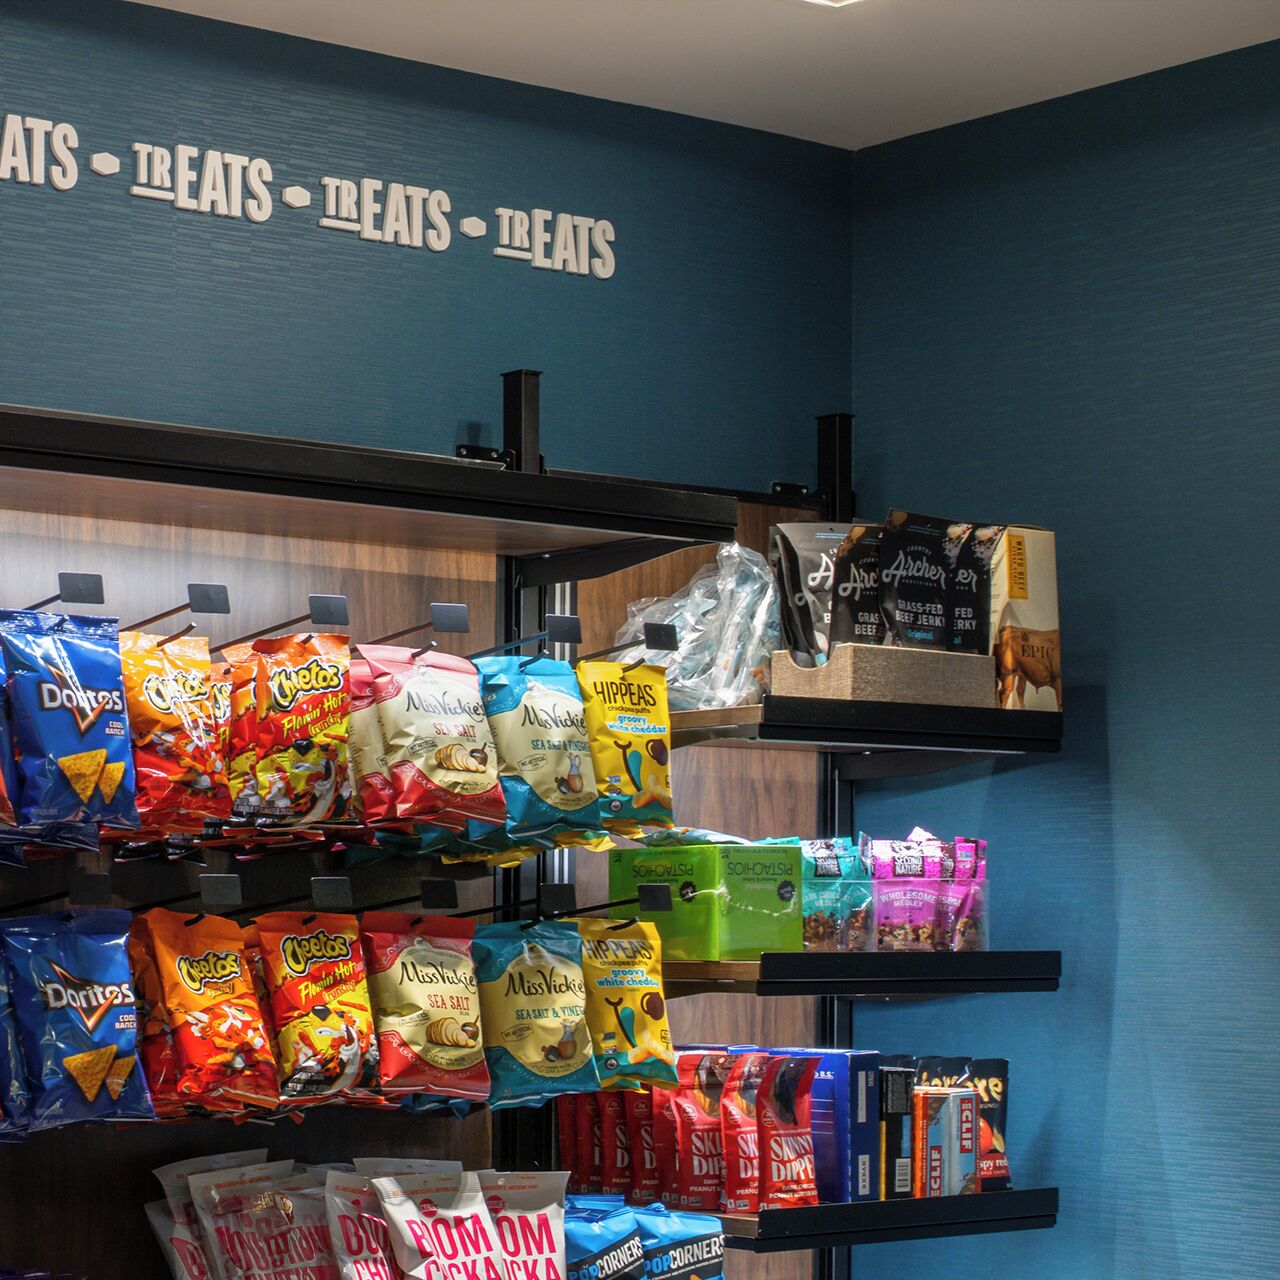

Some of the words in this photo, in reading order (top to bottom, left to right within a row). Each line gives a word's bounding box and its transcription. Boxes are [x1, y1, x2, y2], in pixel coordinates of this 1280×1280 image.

[130, 142, 273, 223] TREATS
[319, 176, 452, 253] TREATS
[493, 207, 617, 280] TREATS
[882, 550, 947, 590] Archer
[898, 599, 944, 615] GRASS-FED
[593, 681, 657, 707] HIPPEAS
[632, 863, 694, 878] PISTACHIOS
[728, 862, 793, 876] PISTACHIOS
[895, 864, 923, 875] NATURE
[879, 890, 937, 904] WHOLESOME
[283, 930, 350, 975] Cheetos
[582, 940, 653, 960] HIPPEAS
[178, 951, 240, 993] Cheetos
[611, 969, 645, 978] groovy
[46, 983, 136, 1009] Doritos
